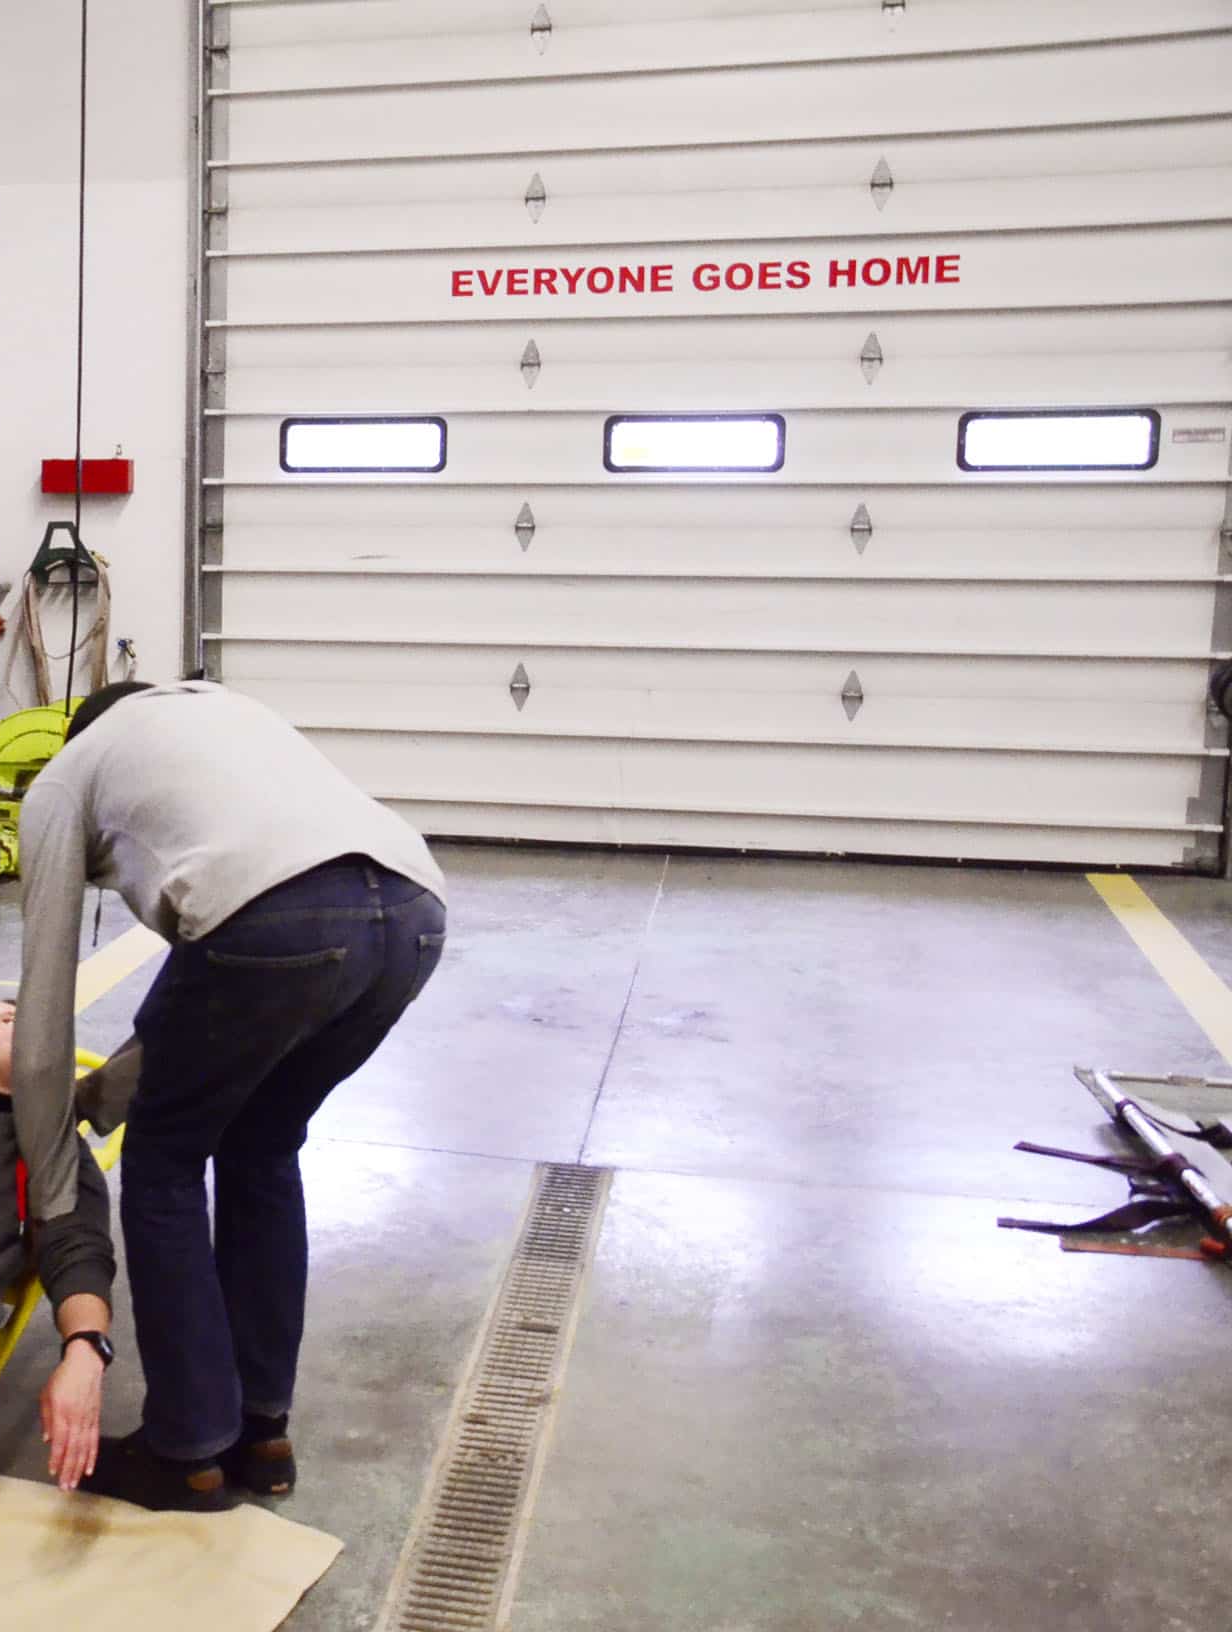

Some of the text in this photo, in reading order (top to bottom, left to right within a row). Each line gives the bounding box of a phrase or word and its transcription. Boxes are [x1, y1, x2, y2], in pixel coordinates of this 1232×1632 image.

[451, 254, 961, 297] EVERYONE GOES HOME
